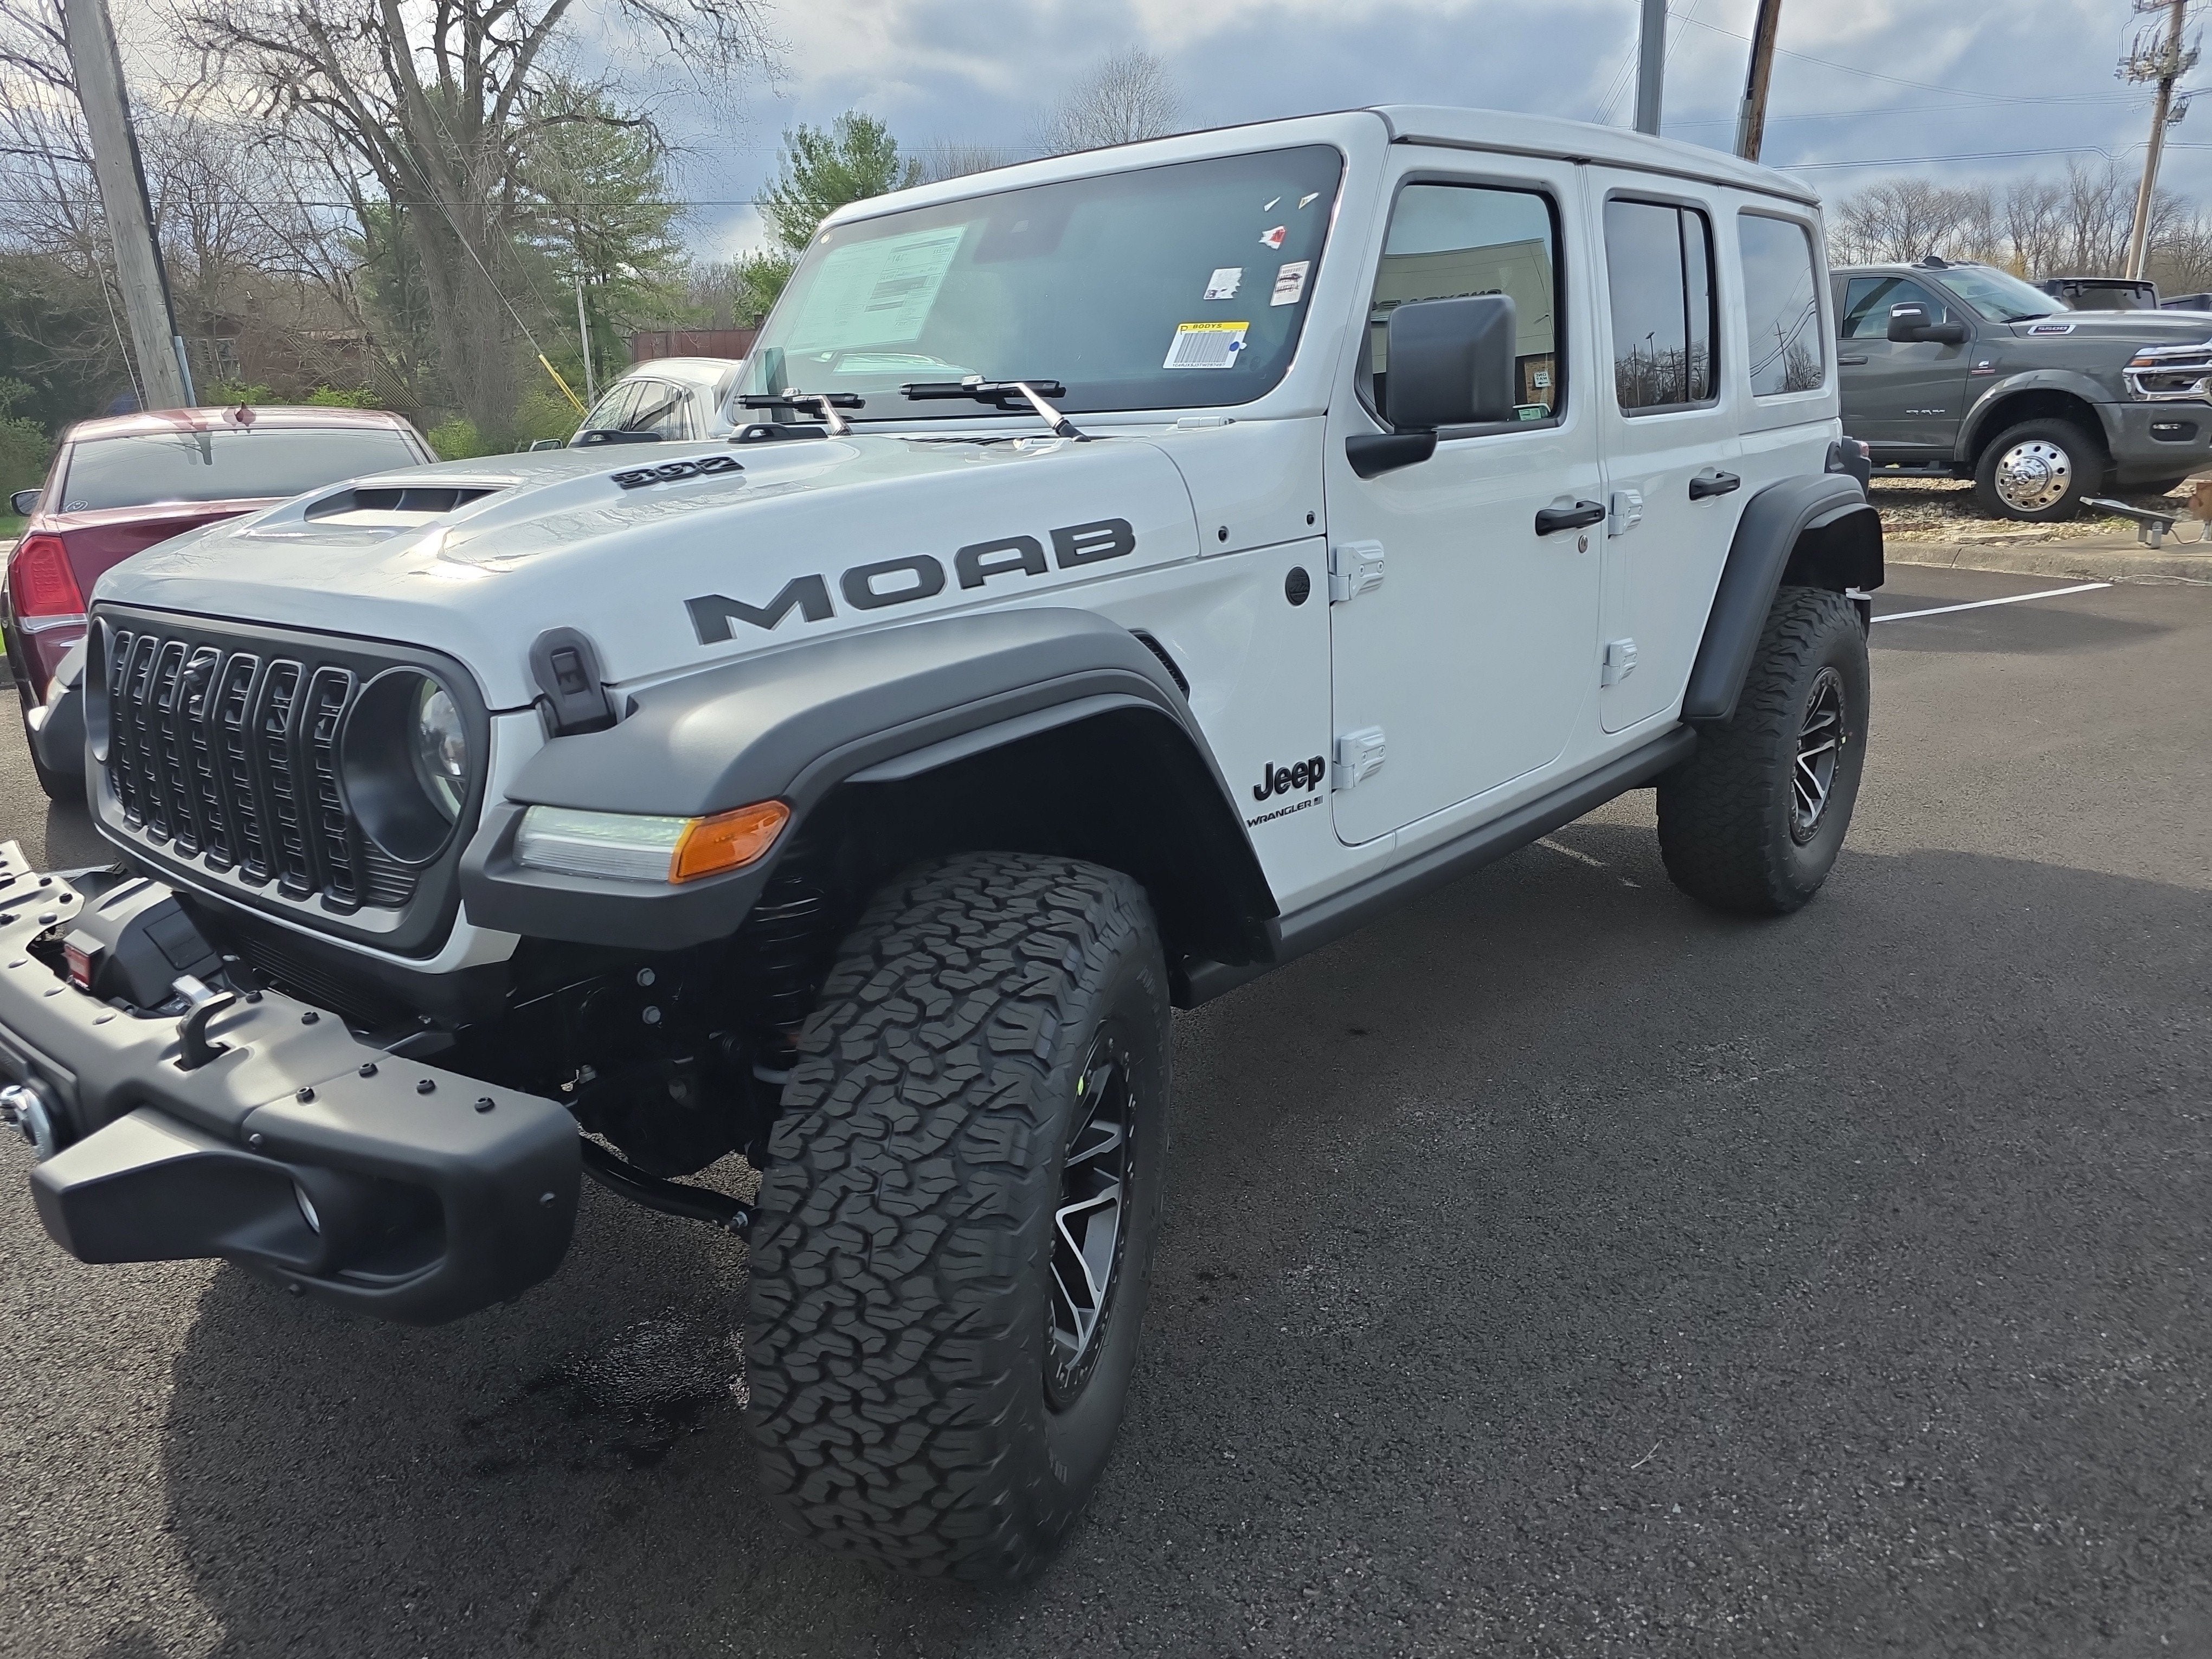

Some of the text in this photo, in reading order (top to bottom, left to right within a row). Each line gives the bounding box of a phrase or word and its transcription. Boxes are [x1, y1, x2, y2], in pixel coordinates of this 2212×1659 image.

[609, 456, 745, 490] 392
[684, 517, 1136, 646] MOAB
[1253, 755, 1326, 801] Jeep
[1246, 799, 1312, 828] WRANGLER
